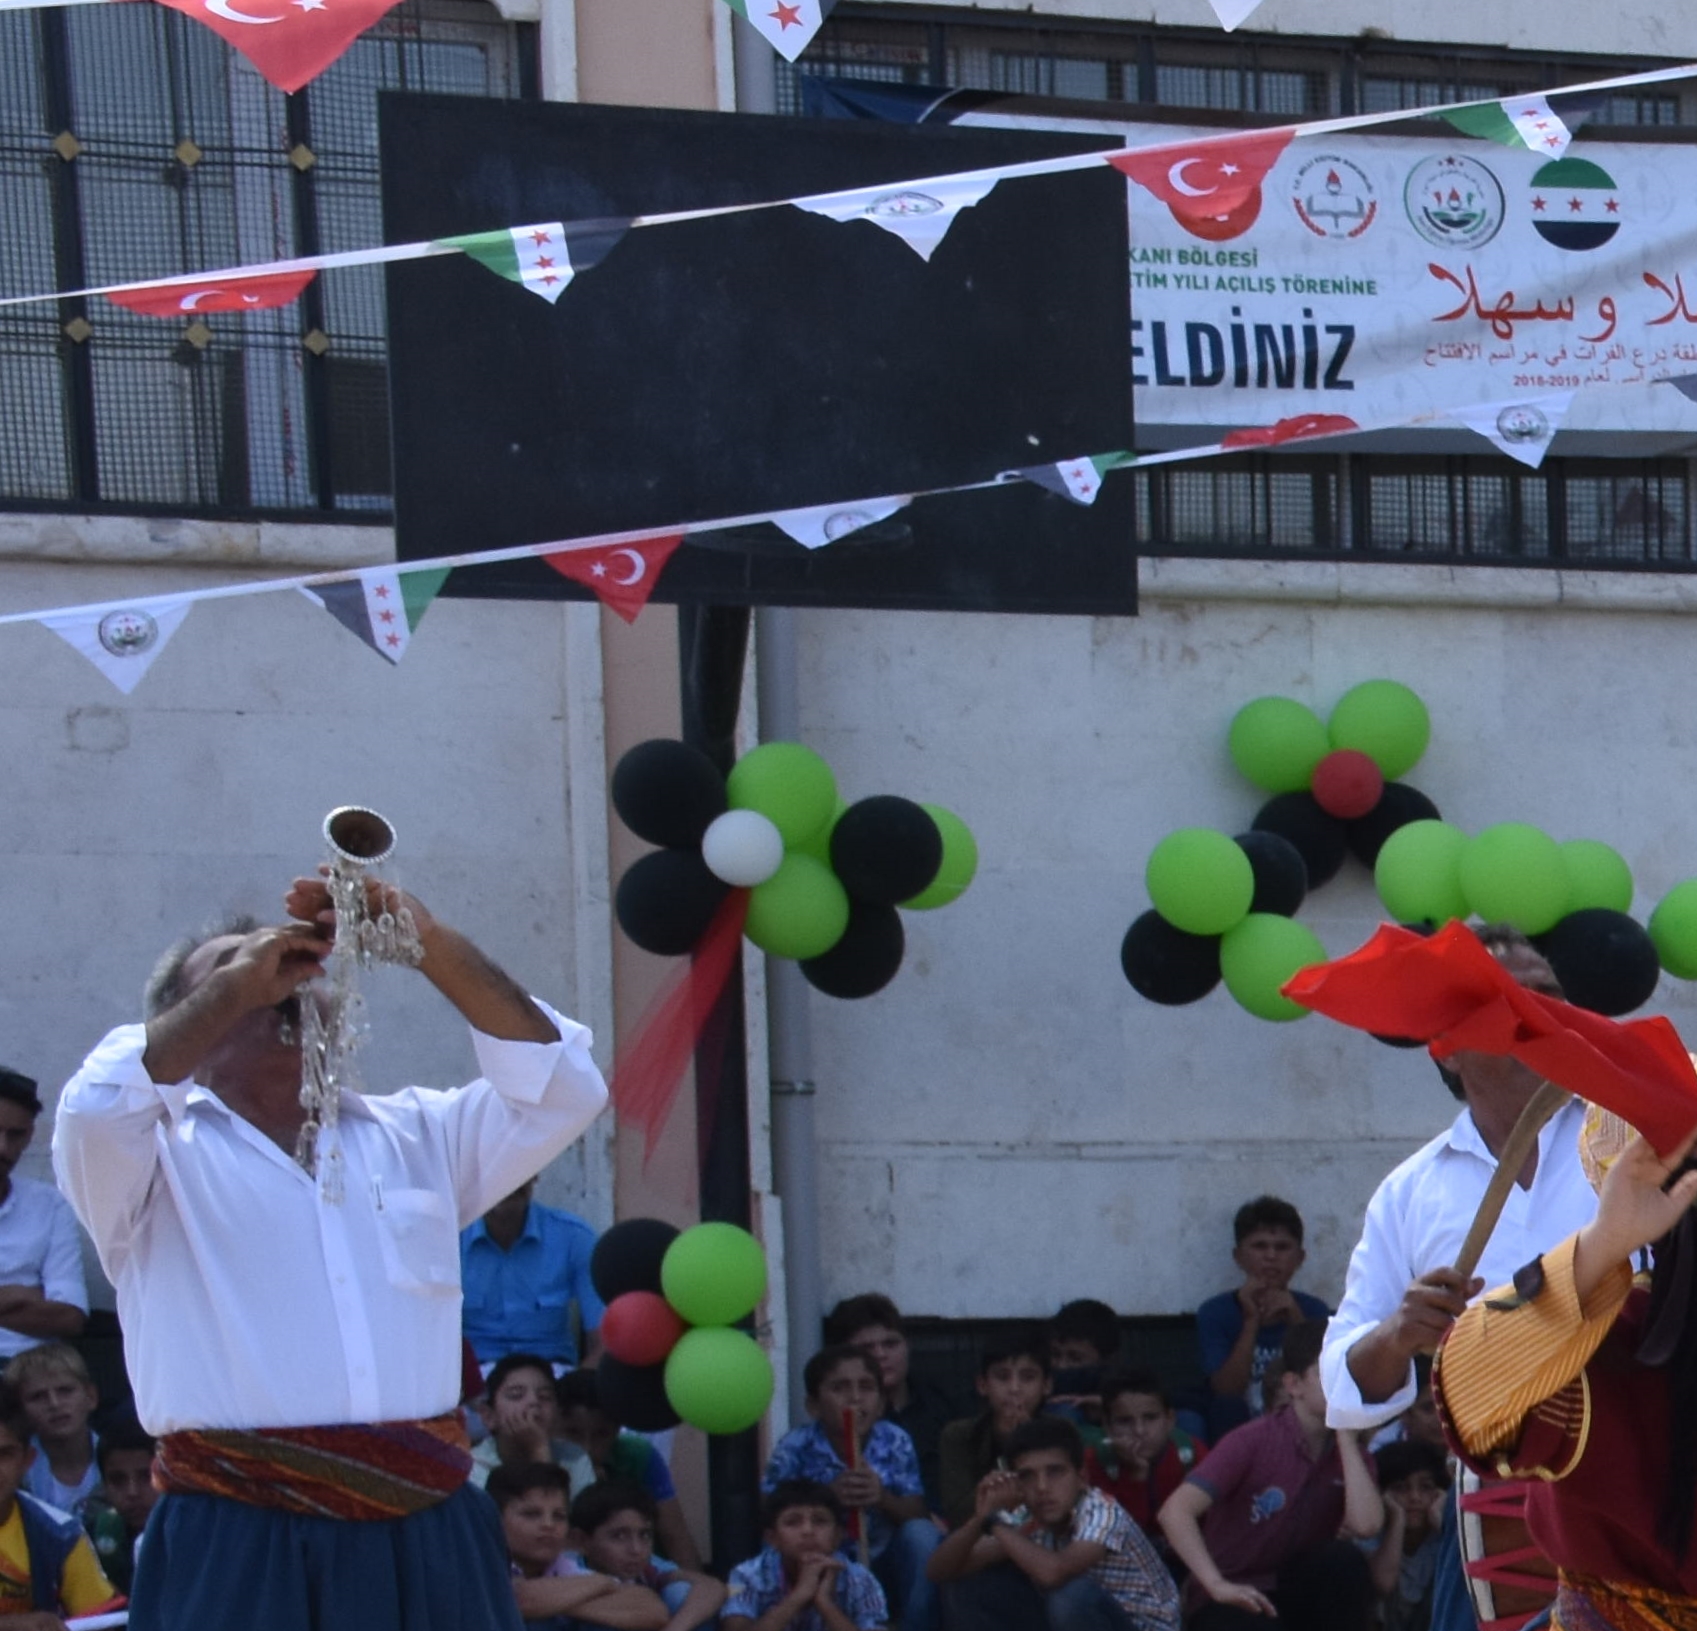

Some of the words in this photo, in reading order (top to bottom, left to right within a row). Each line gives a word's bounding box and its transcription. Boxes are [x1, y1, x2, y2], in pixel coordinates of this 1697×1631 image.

[1178, 246, 1258, 267] BÖLGESİ
[1130, 271, 1168, 289] TİM
[1174, 274, 1209, 290] YILI
[1214, 277, 1276, 294] AÇILIŞ
[1282, 274, 1378, 295] TÖRENİNE
[1514, 375, 1580, 387] 2018-2019
